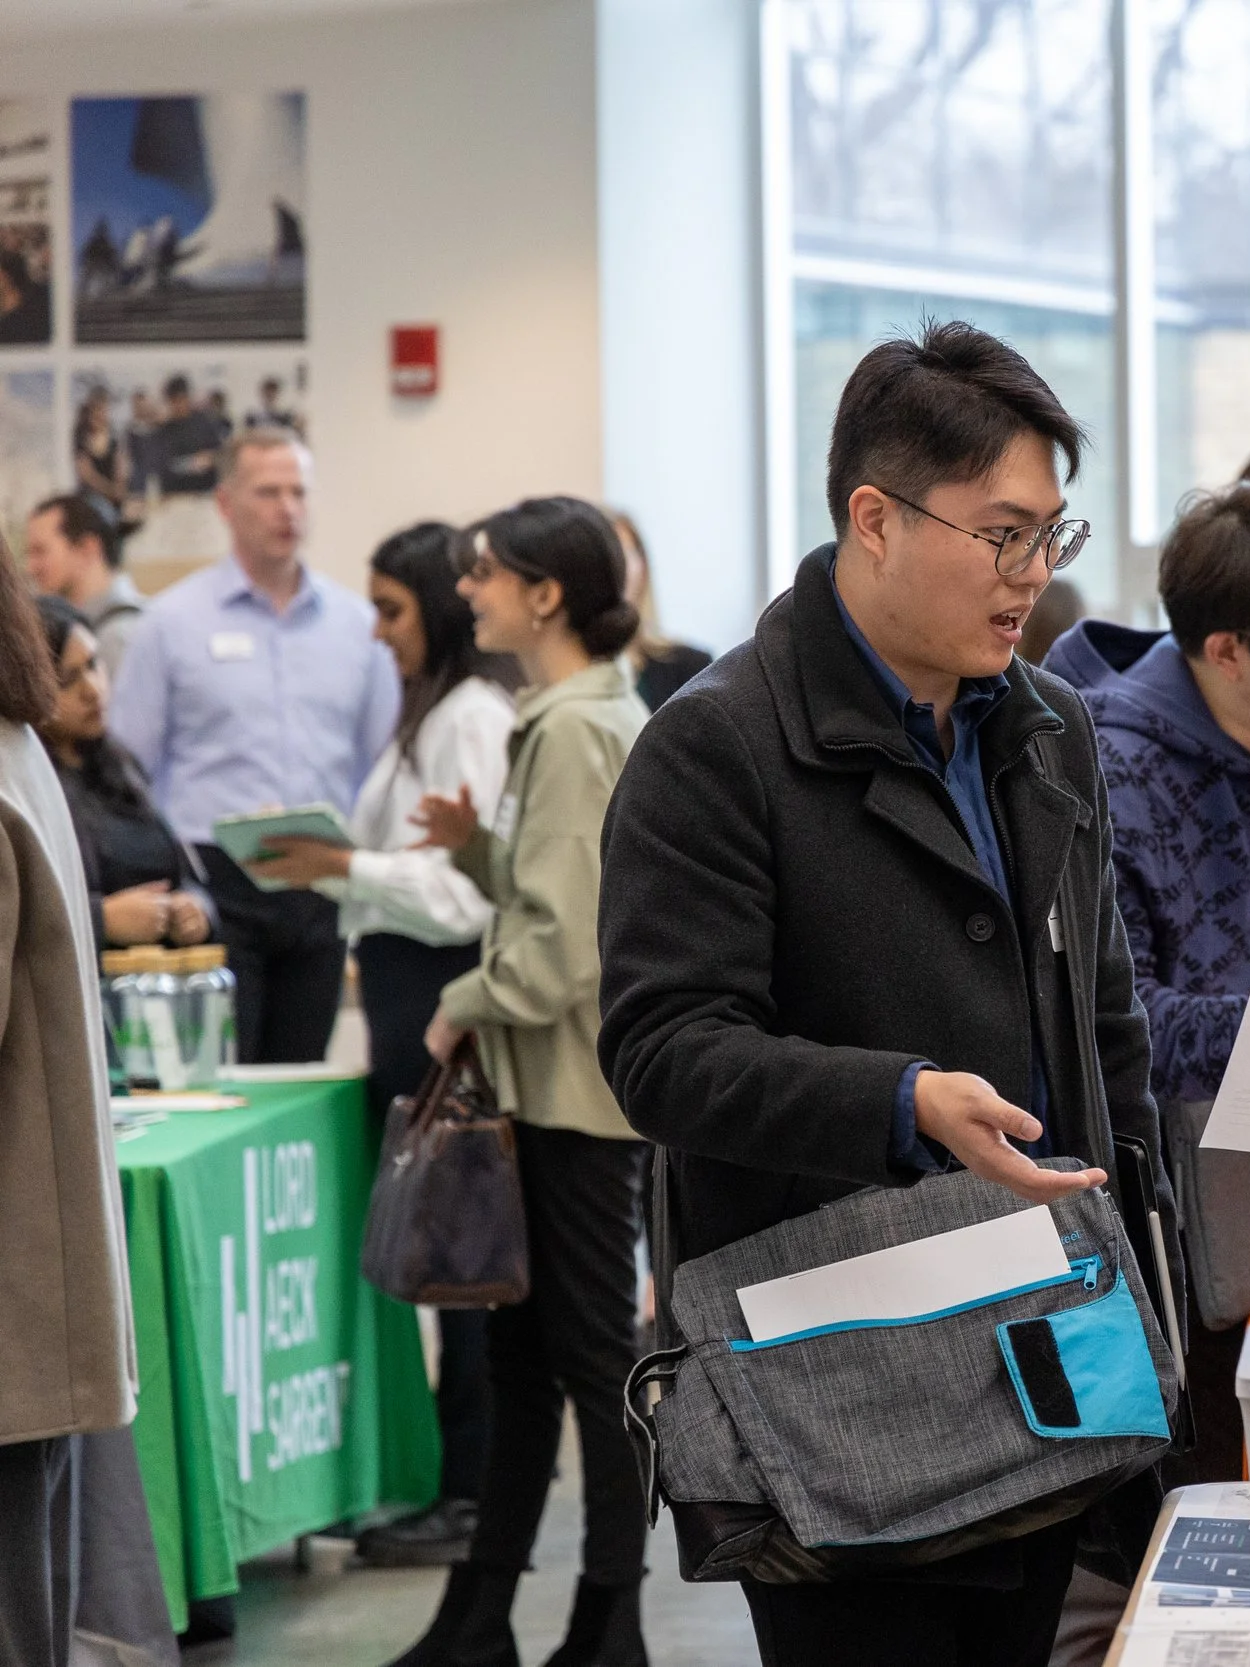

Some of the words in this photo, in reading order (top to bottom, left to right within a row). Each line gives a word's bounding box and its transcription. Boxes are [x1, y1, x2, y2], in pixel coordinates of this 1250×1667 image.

[261, 1140, 317, 1234] LORD
[265, 1257, 319, 1348] AECK
[266, 1361, 350, 1471] SARGENT
